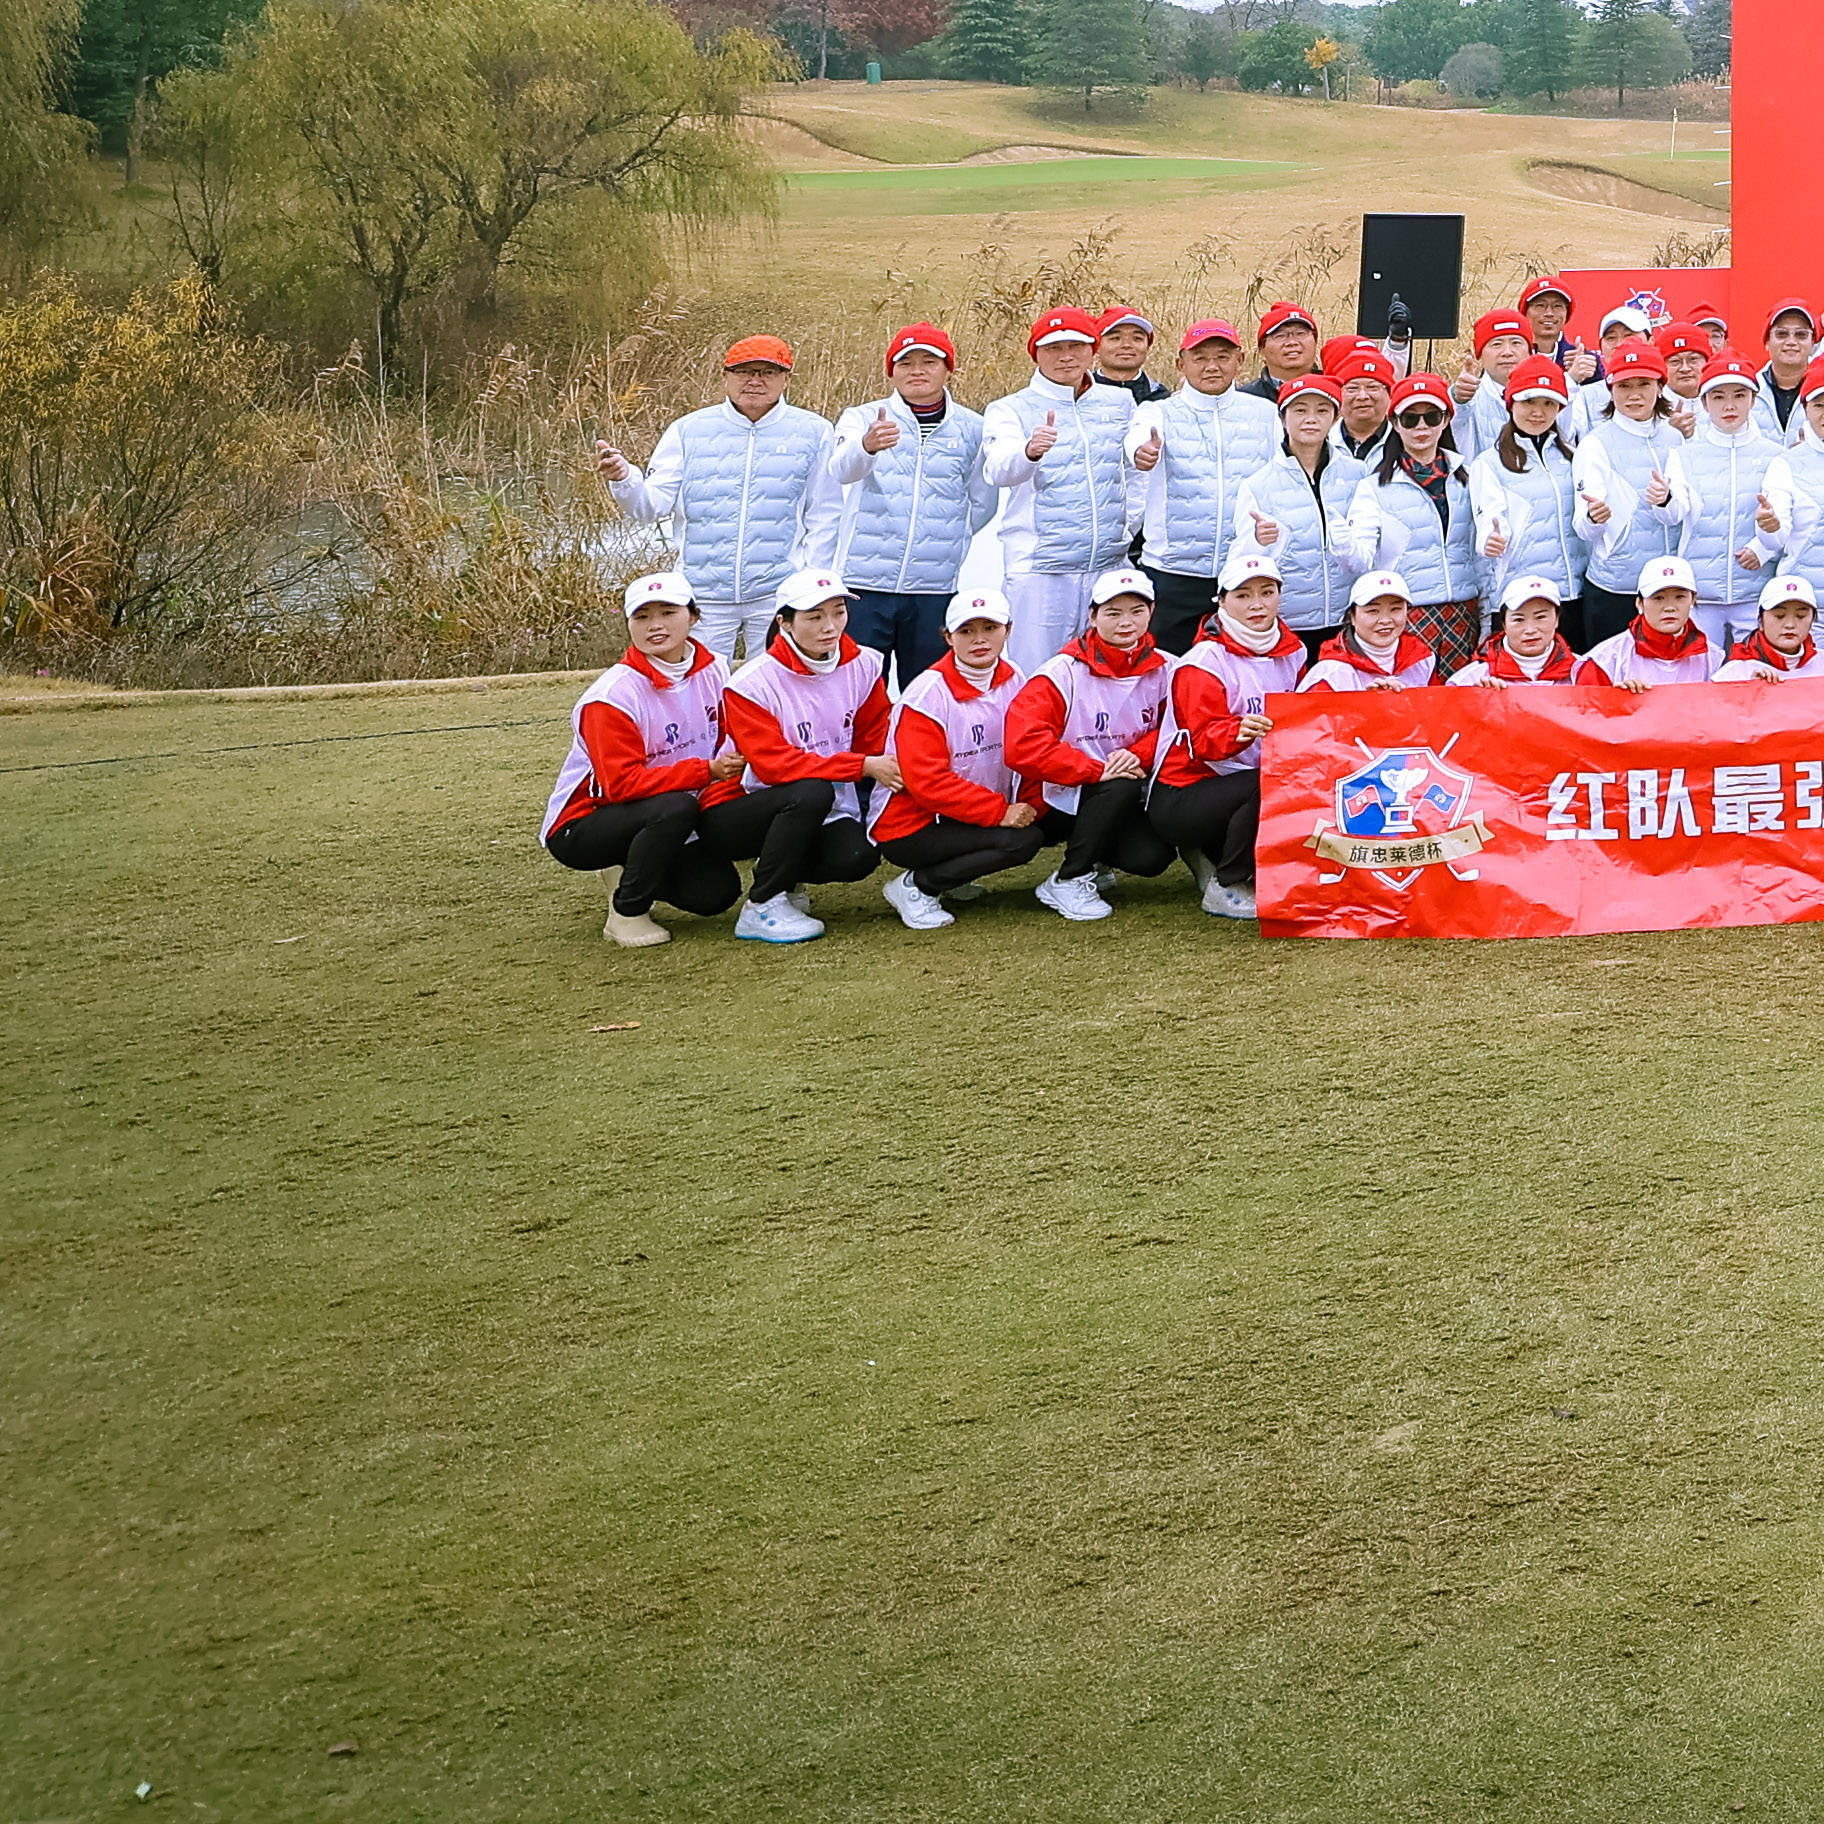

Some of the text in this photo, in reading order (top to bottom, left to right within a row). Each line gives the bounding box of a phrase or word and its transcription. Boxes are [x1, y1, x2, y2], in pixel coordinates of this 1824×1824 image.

[1348, 841, 1442, 864] 旗忠莱德杯
